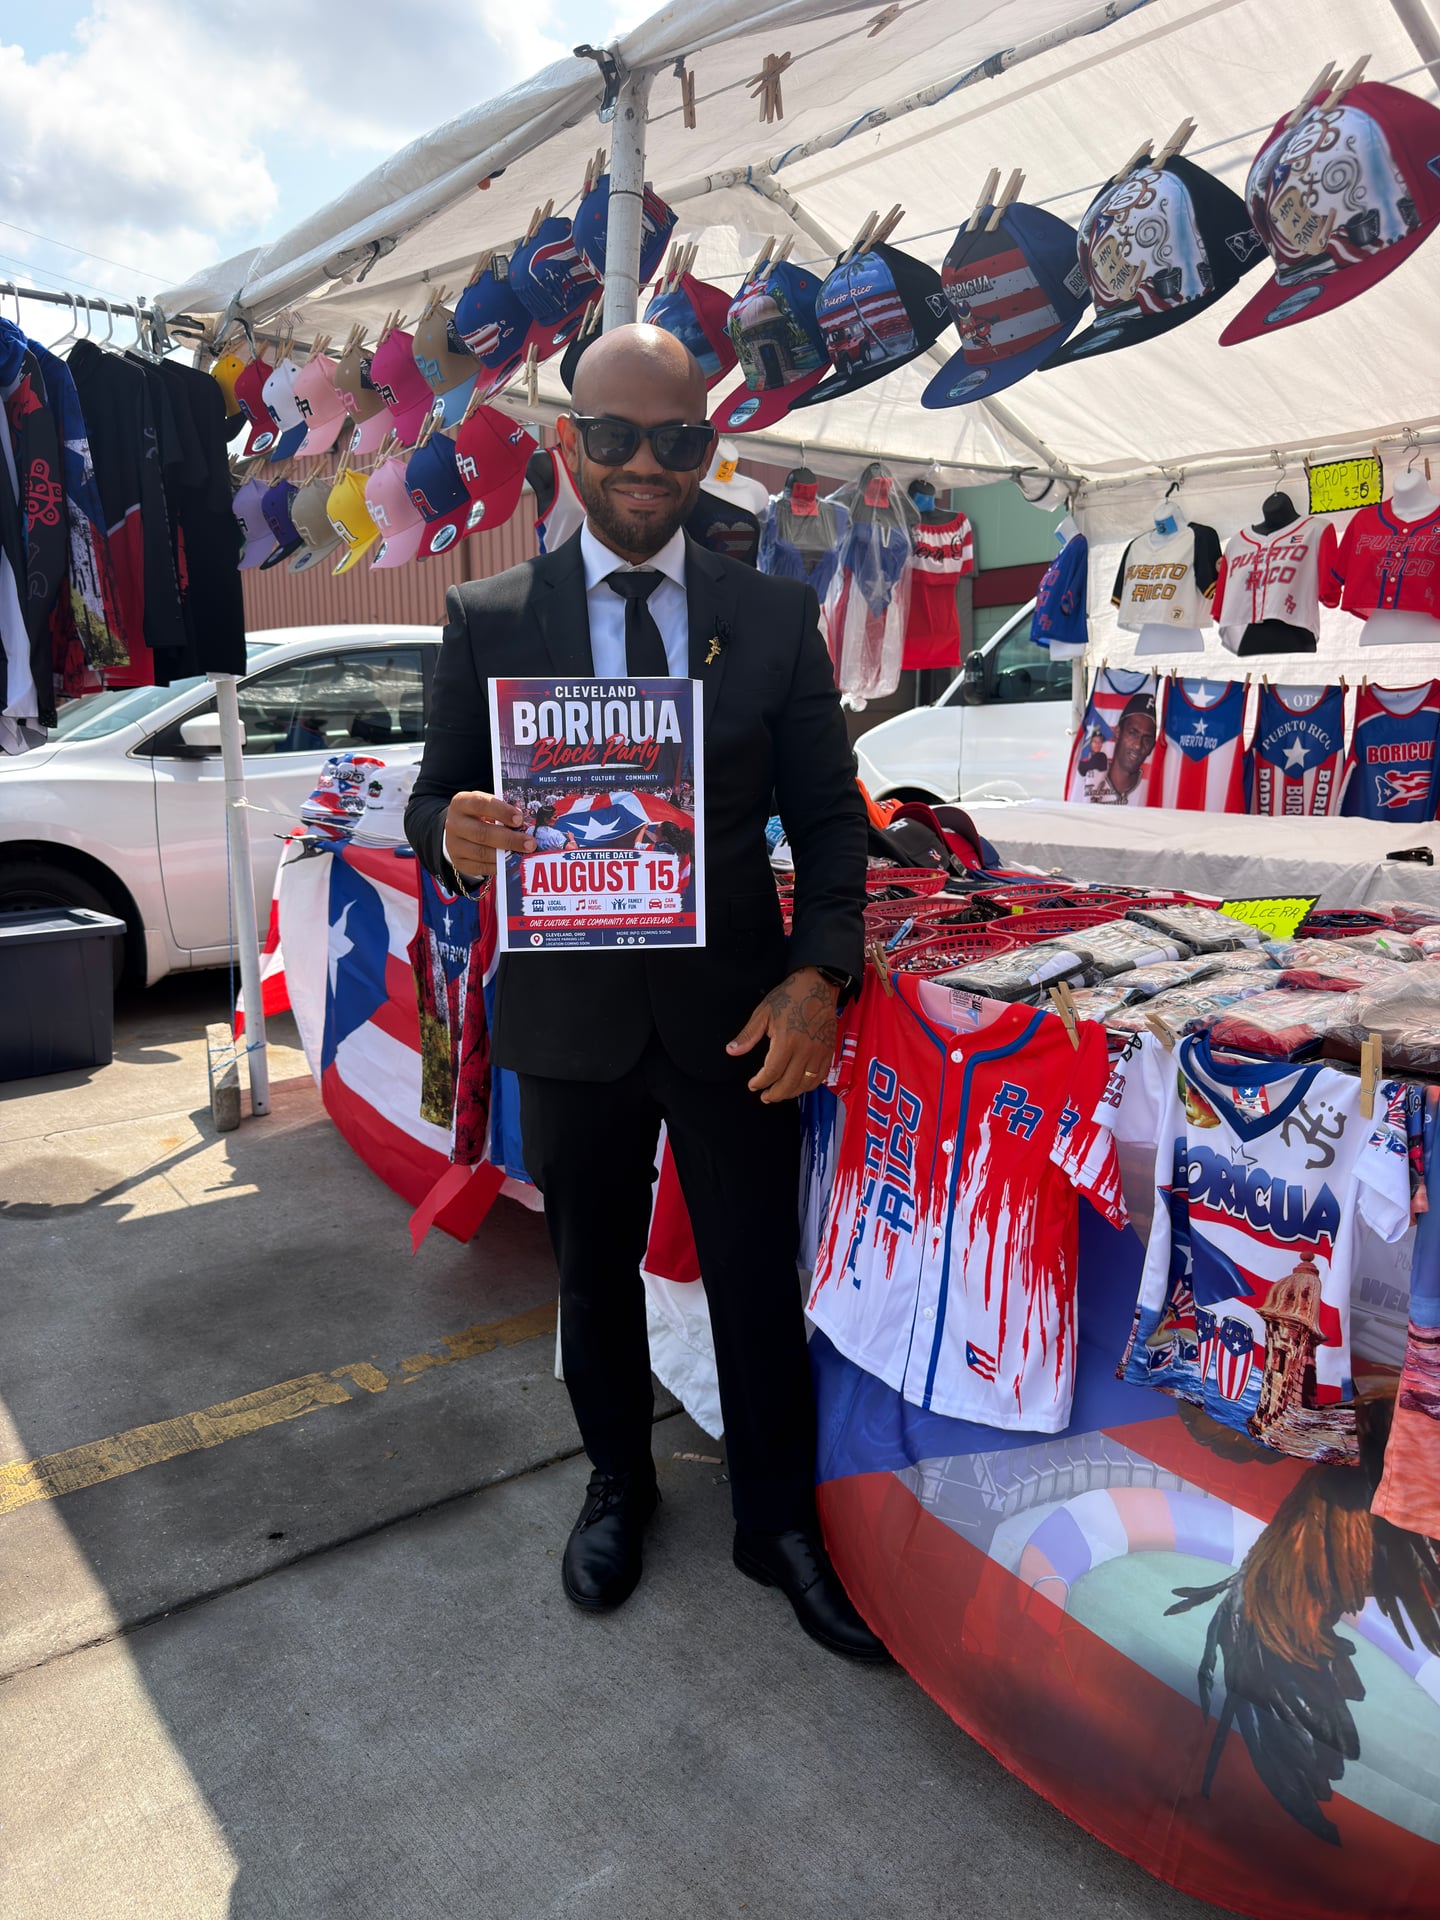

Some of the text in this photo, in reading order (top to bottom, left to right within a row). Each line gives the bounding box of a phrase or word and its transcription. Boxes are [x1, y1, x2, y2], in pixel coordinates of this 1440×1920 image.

[824, 285, 873, 308] Puerto Rico
[1315, 461, 1378, 488] CROP TOP
[1125, 563, 1187, 584] PUERTO
[1229, 545, 1309, 577] PUERTO
[1246, 566, 1296, 591] RICO
[1131, 584, 1176, 602] RICO
[555, 686, 636, 698] CLEVELAND
[513, 700, 682, 746] BORIQUA
[1262, 720, 1306, 751] PUERTO
[530, 733, 660, 772] Block Party
[1204, 737, 1218, 749] RICO
[570, 851, 634, 860] SAVE THE DATE
[531, 860, 674, 893] AUGUST 15
[573, 918, 587, 926] ONE
[625, 917, 639, 925] ONE
[876, 1084, 923, 1234] RICO
